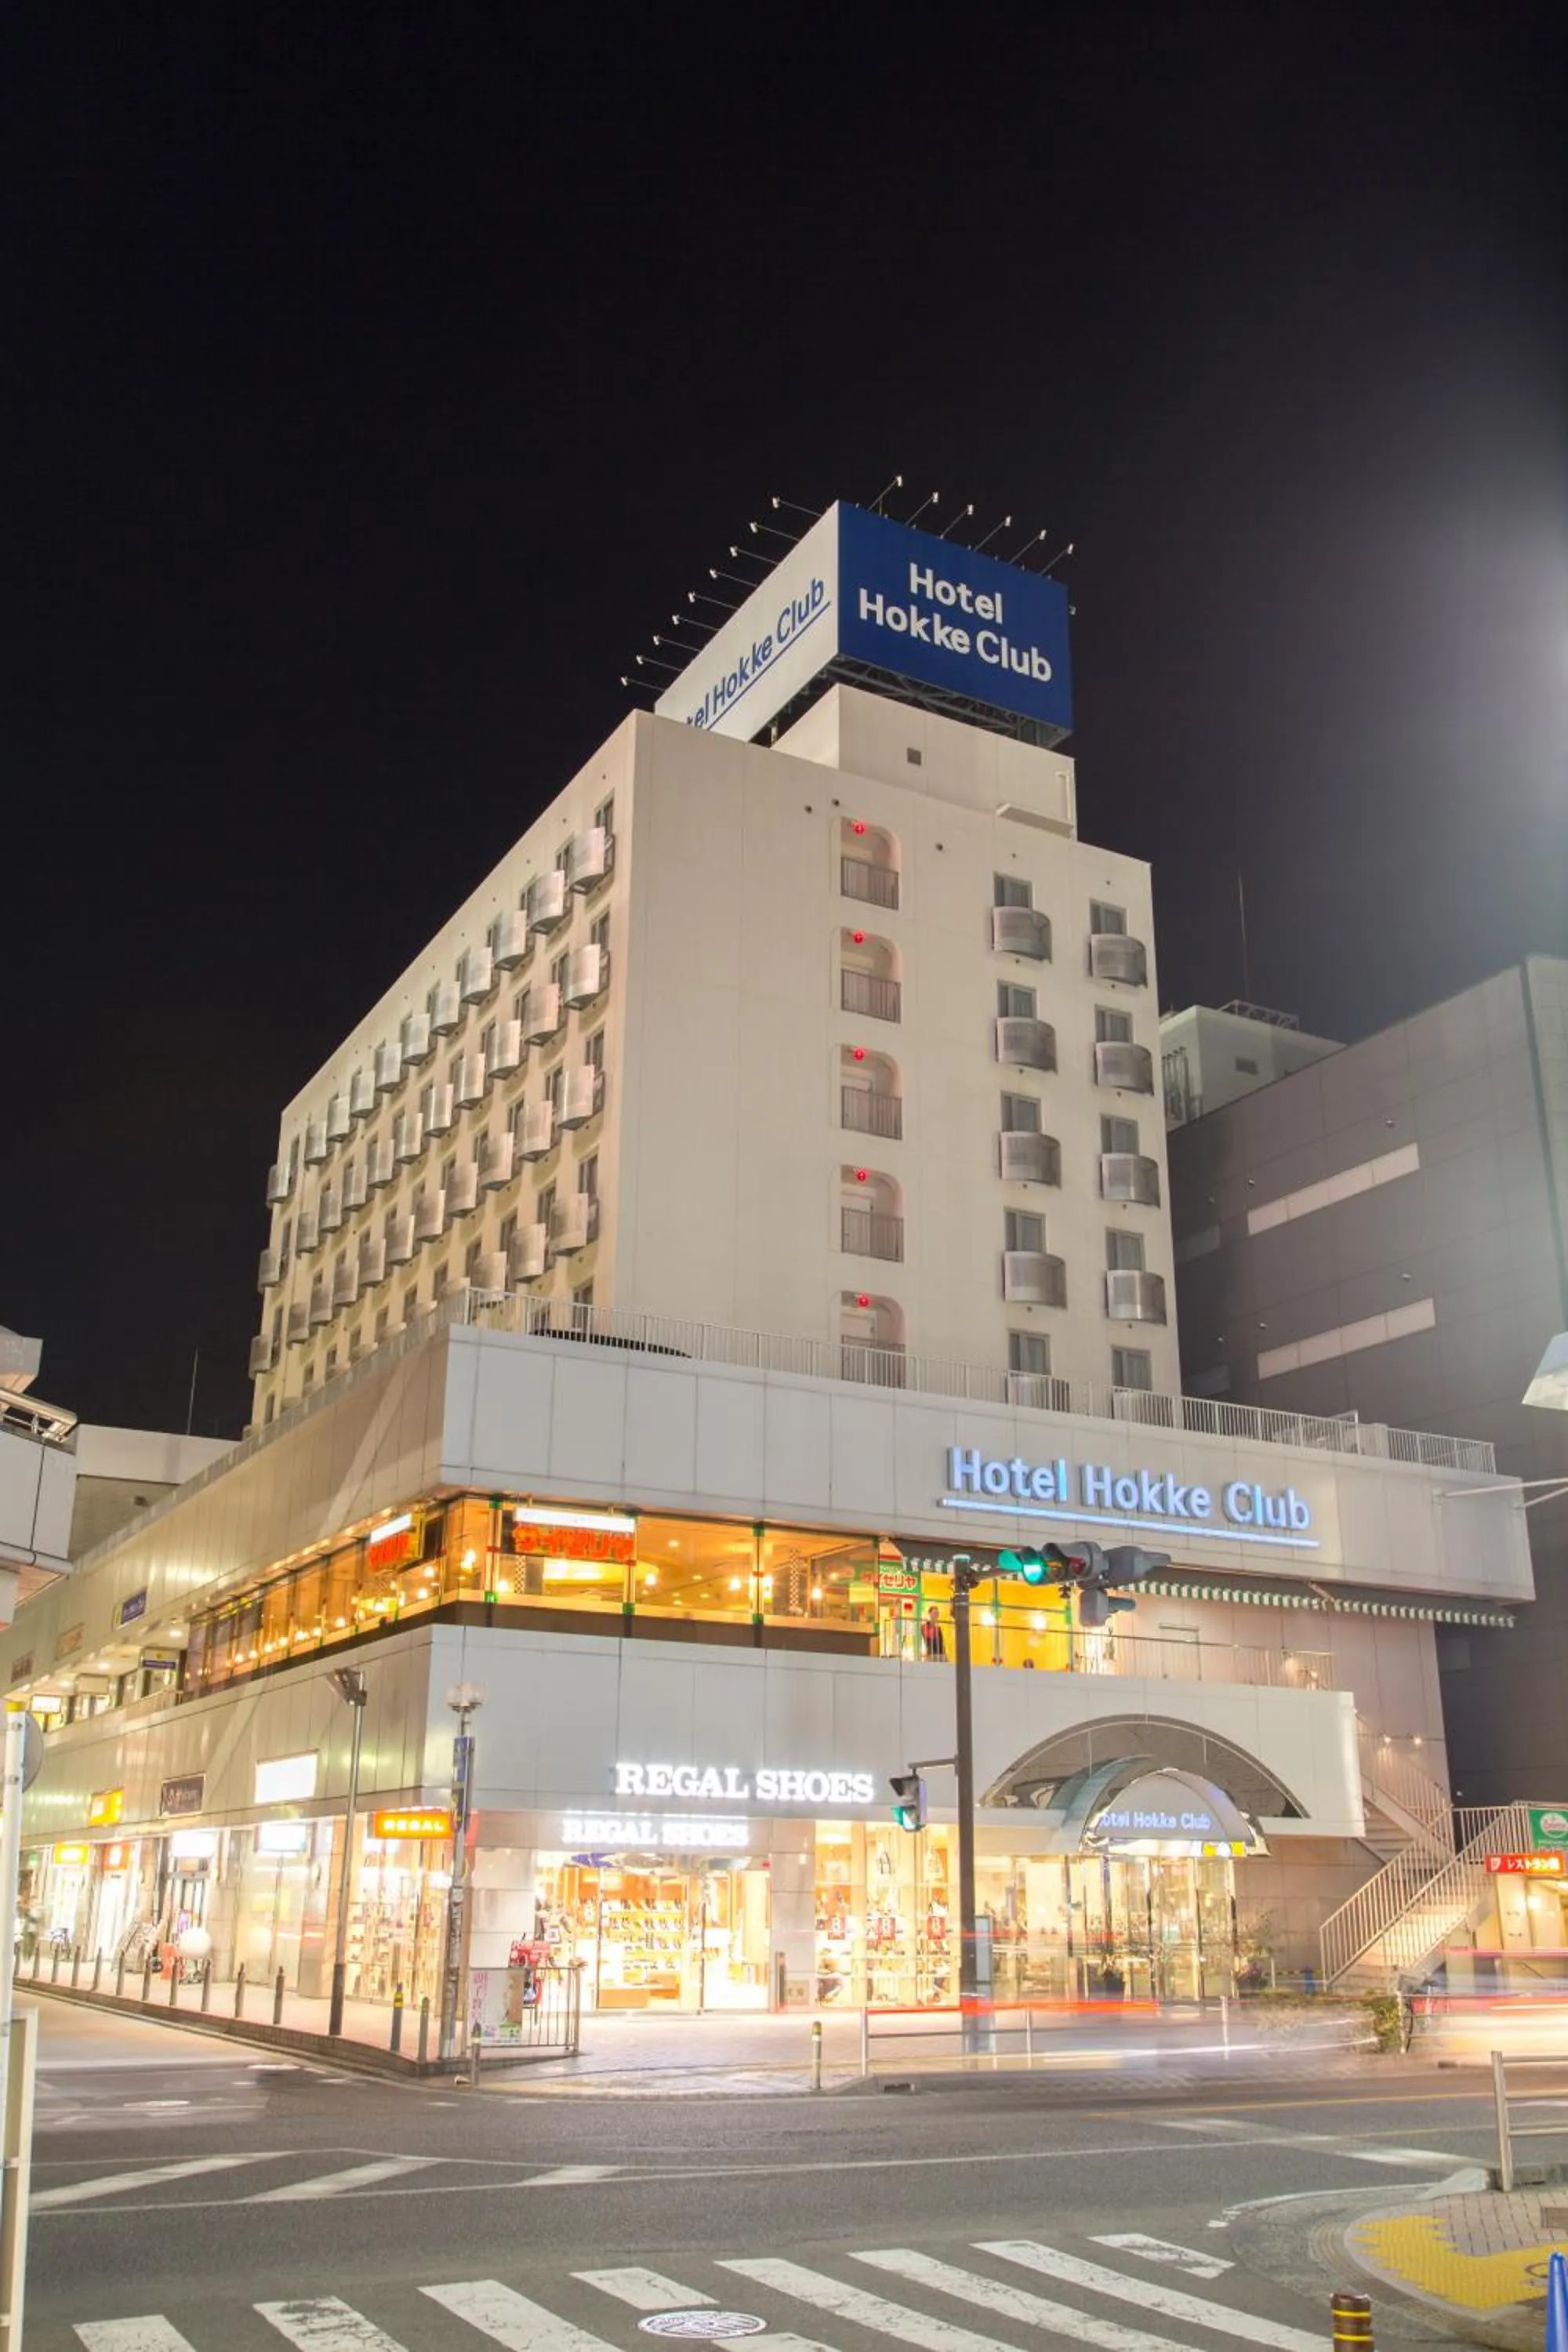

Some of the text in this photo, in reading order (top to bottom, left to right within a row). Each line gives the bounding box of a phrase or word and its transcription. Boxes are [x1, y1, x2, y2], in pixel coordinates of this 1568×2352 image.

[909, 561, 1003, 625] Hotel
[713, 634, 773, 715] Hokke
[776, 577, 825, 644] Club
[859, 587, 1052, 682] Hokke Club
[947, 1446, 1311, 1530] Hotel Hokke Club
[615, 1762, 874, 1802] REGAL SHOES
[561, 1818, 749, 1846] REGAL SHOES
[1101, 1811, 1211, 1831] otel Hokke Club
